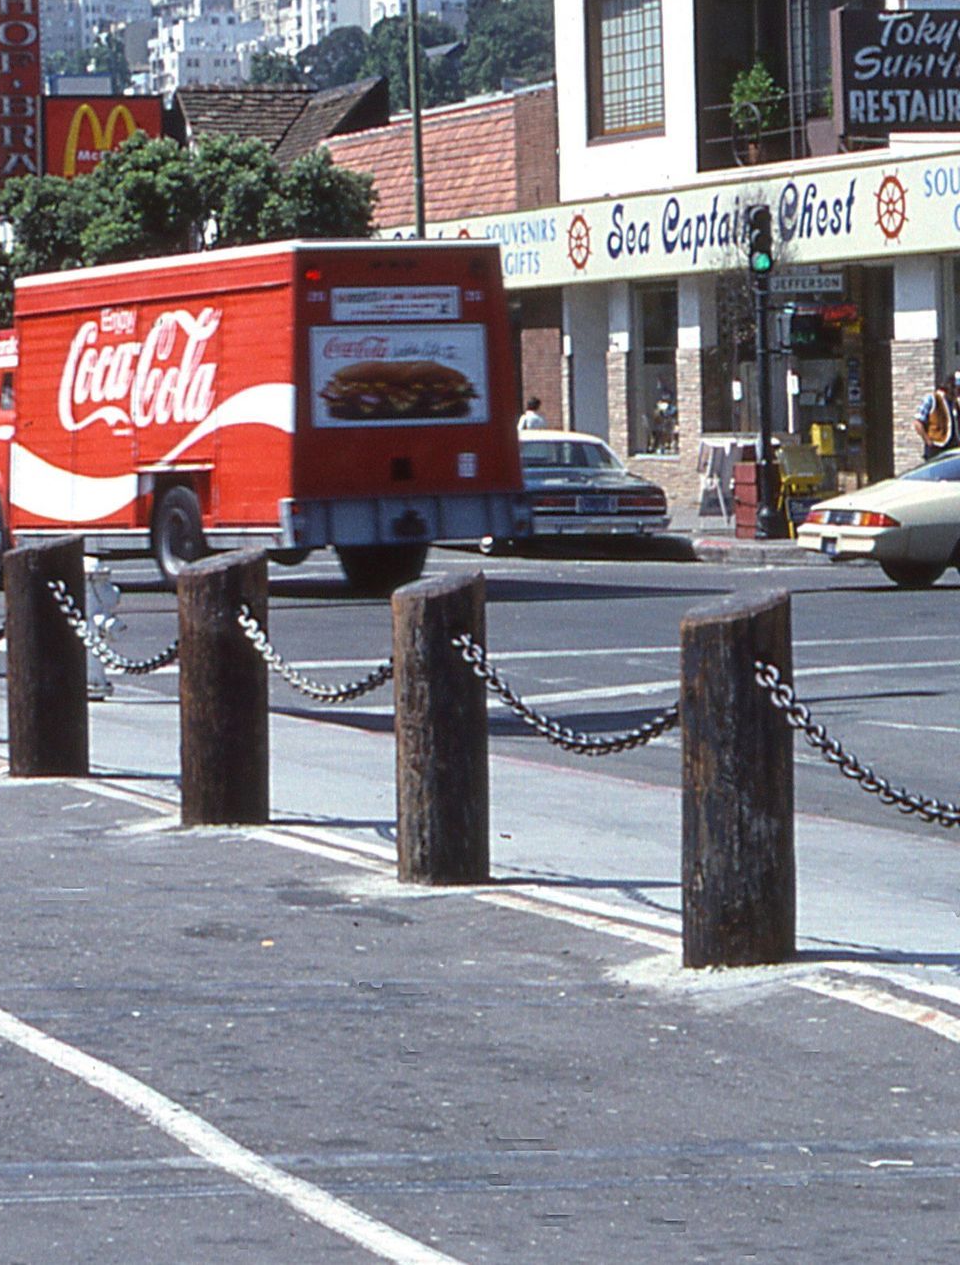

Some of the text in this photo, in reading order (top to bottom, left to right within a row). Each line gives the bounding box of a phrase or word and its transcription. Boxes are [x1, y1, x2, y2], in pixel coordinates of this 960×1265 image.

[878, 12, 960, 52] Toky
[486, 218, 556, 246] SOUVENIRS
[607, 203, 650, 259] Sea
[779, 177, 858, 242] Chest
[504, 250, 541, 276] GIFTS
[773, 276, 841, 291] JEFFERSON
[57, 306, 224, 432] Coca-Cola
